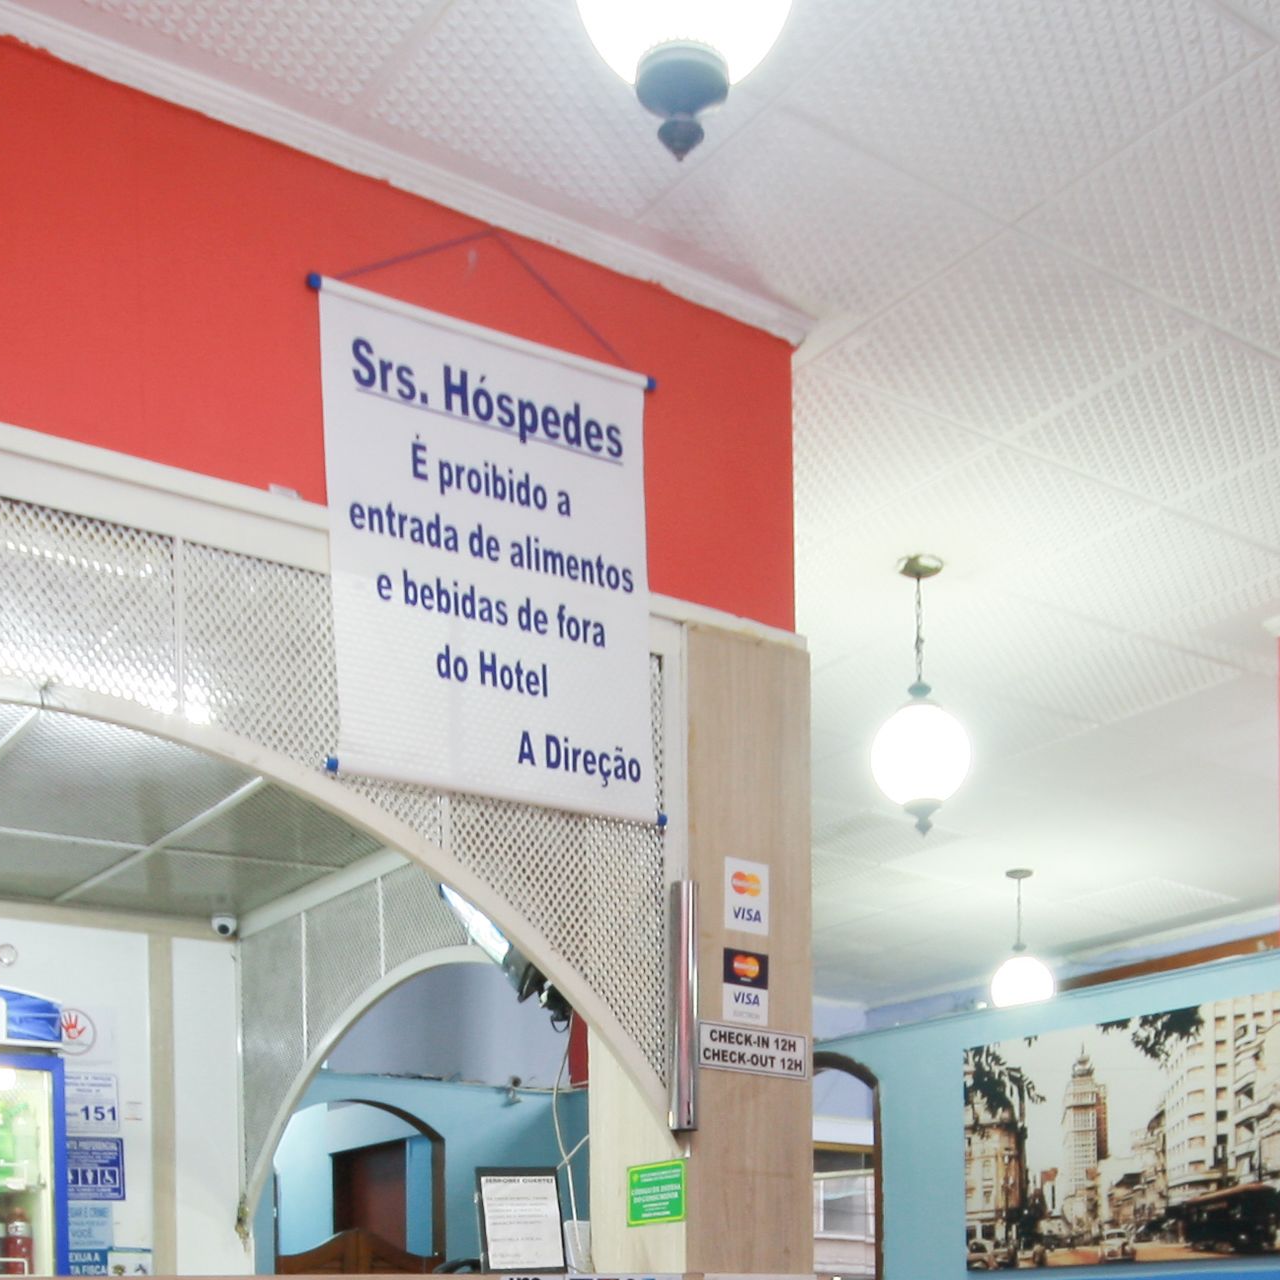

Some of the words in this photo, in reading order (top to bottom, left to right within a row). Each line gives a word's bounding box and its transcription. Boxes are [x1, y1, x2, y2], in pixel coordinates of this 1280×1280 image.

[351, 337, 429, 405] Srs.
[444, 363, 624, 459] Hóspedes
[411, 434, 429, 480] É
[439, 456, 547, 511] proibido
[557, 488, 572, 517] a
[349, 499, 460, 553] entrada
[469, 523, 501, 562] de
[510, 535, 634, 593] alimentos
[376, 571, 393, 601] e
[403, 569, 509, 627] bebidas
[517, 598, 549, 635] de
[557, 605, 606, 648] fora
[436, 645, 469, 683] do
[479, 650, 549, 697] Hotel
[518, 731, 536, 766] A
[546, 733, 642, 788] Direção
[733, 906, 762, 923] VISA
[733, 991, 761, 1007] VISA
[703, 1047, 776, 1069] CHECK-OUT
[780, 1057, 803, 1072] 12H
[709, 1029, 770, 1050] CHECK-IN
[774, 1038, 797, 1052] 12H
[80, 1105, 117, 1121] 151
